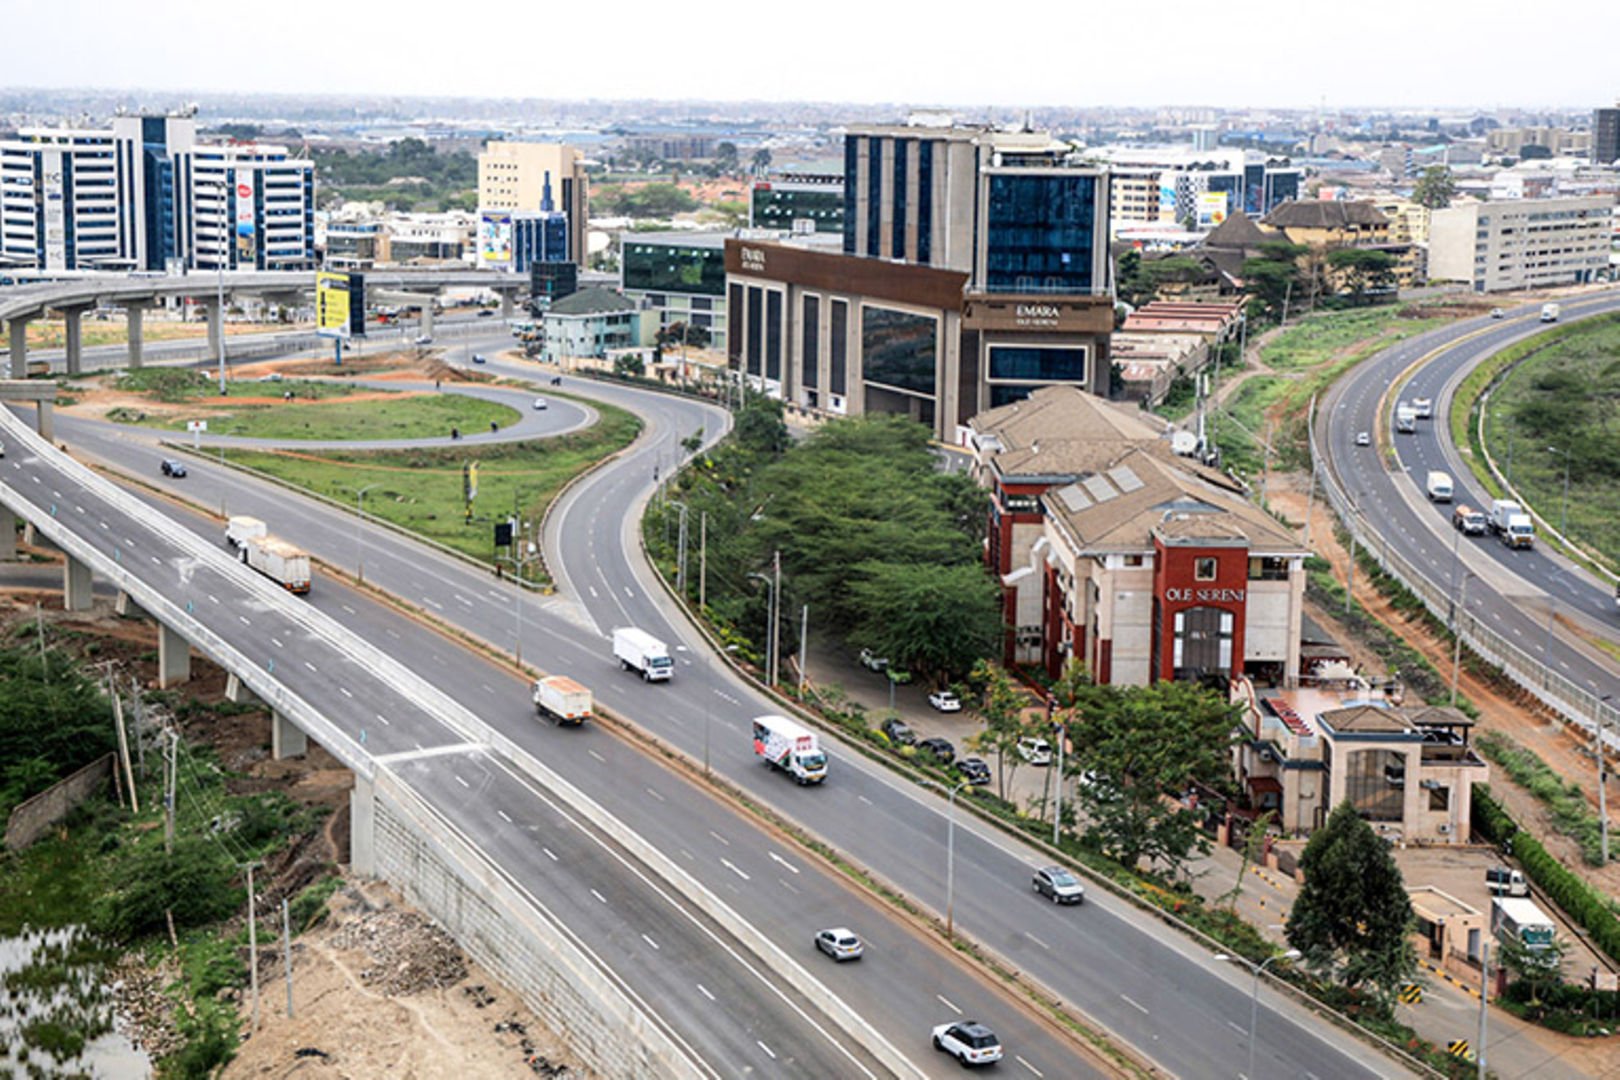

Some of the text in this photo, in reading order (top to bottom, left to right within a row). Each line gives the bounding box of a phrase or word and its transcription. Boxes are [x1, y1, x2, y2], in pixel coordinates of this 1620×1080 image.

[1016, 303, 1060, 317] EMARA
[1166, 587, 1245, 601] OLE SERENI
